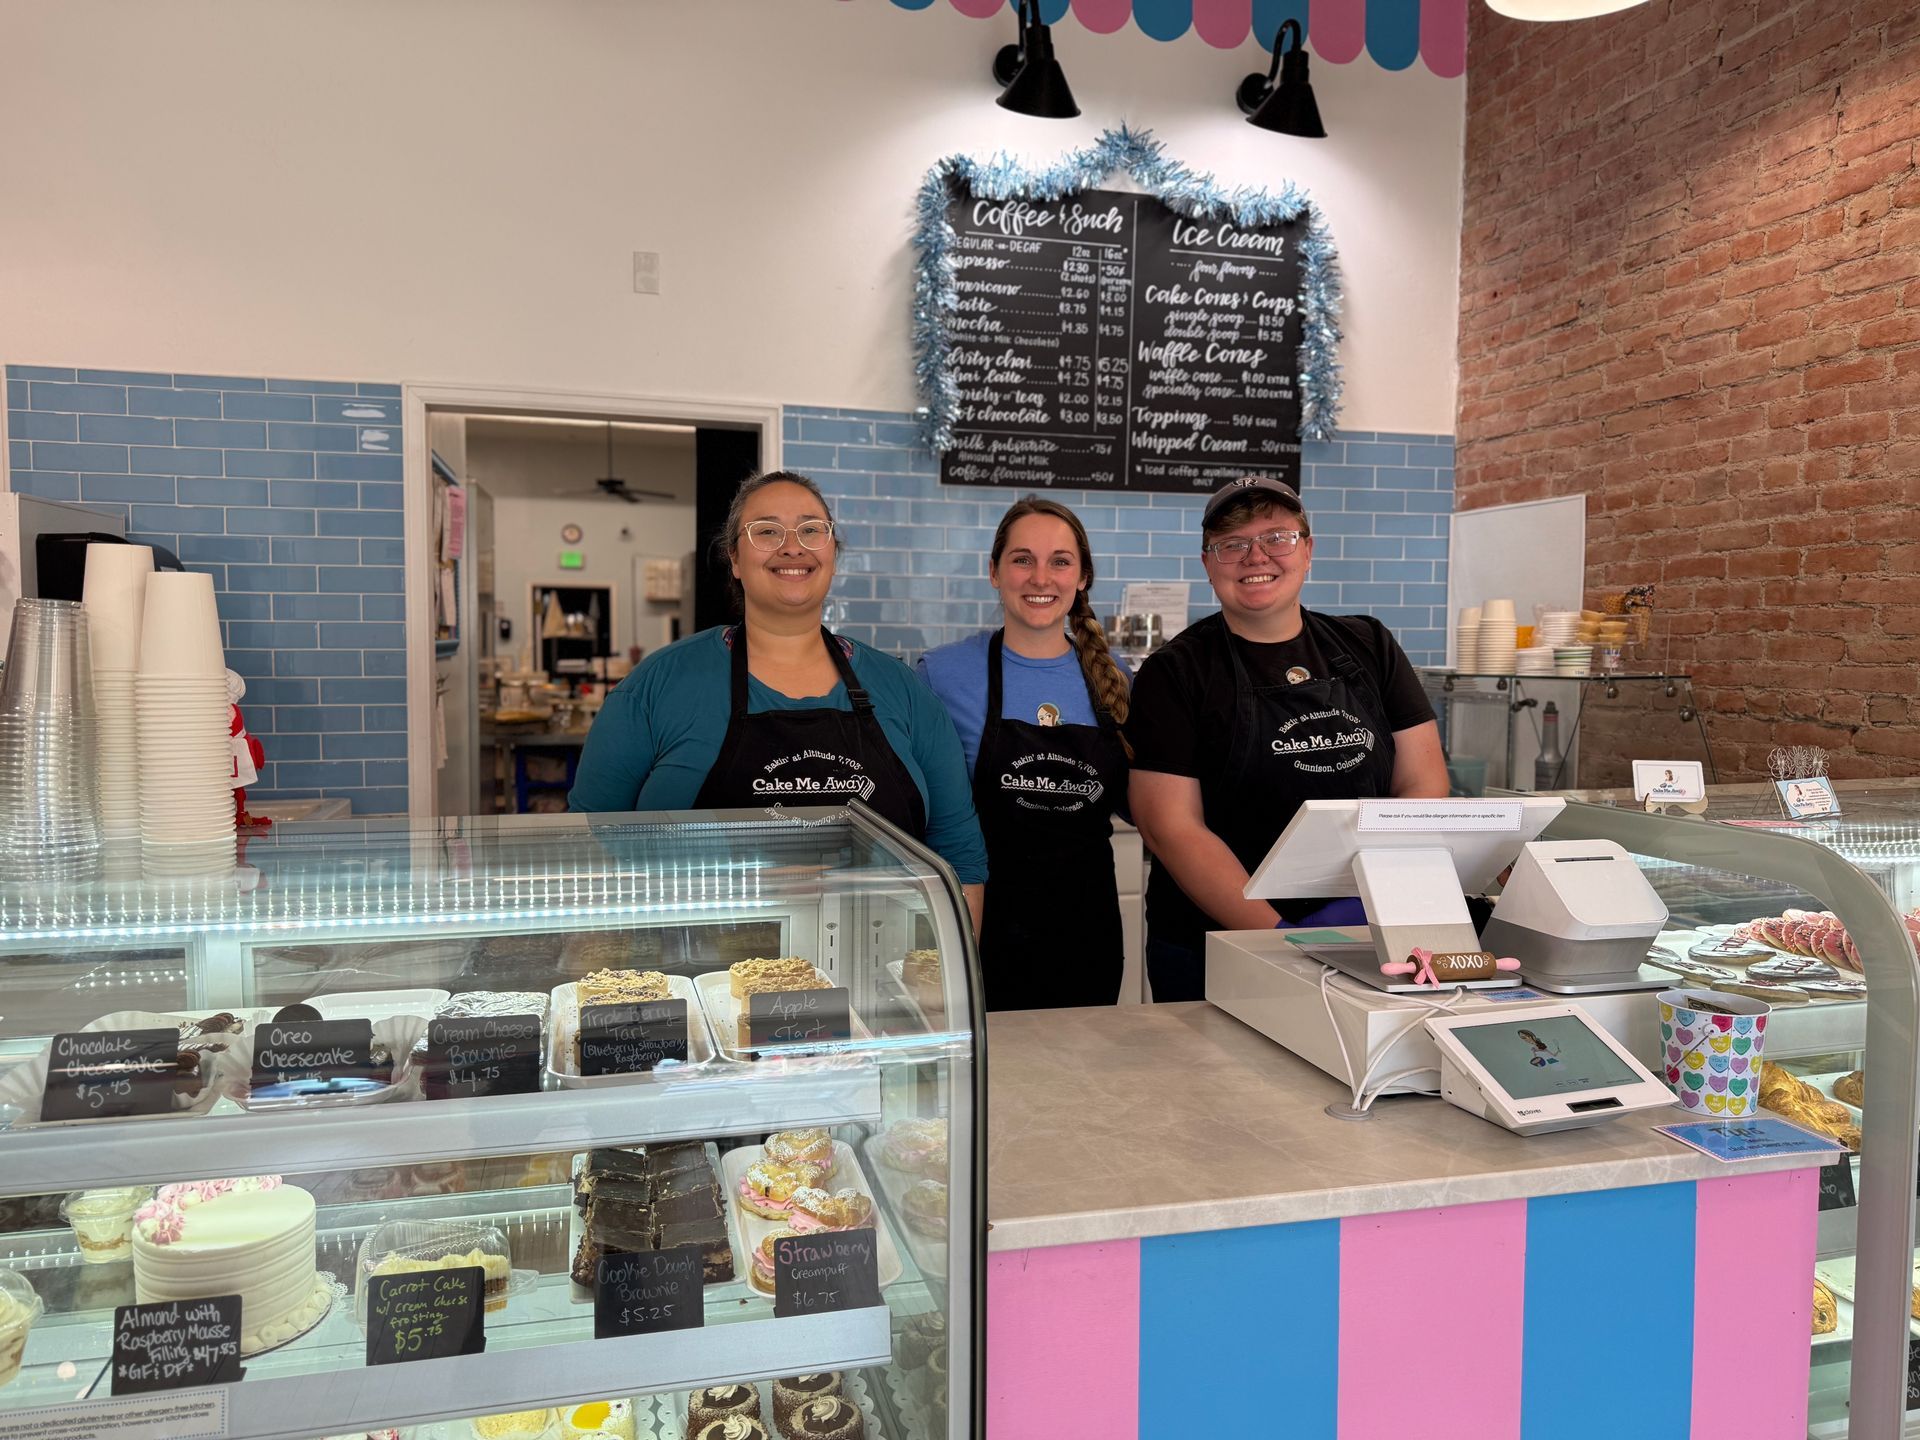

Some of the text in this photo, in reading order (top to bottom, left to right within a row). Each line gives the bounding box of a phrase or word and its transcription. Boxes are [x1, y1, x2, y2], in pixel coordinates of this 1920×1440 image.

[973, 200, 1123, 235] Coffee Such
[1010, 239, 1042, 253] DECAF
[1172, 220, 1284, 255] Ice Cream
[959, 297, 998, 312] atte
[1059, 302, 1086, 314] $3.75
[1145, 284, 1295, 315] Cake Cones Cups
[1164, 309, 1209, 326] single
[1208, 312, 1245, 328] scoop
[1164, 325, 1206, 339] double
[1206, 328, 1240, 344] scoop
[946, 346, 995, 370] dirty
[996, 349, 1033, 369] chai
[1138, 341, 1267, 368] Waffle Cones
[983, 369, 1026, 383] latte
[1058, 371, 1089, 387] $4.25
[1149, 369, 1190, 384] waffle
[1192, 371, 1222, 383] cone
[1143, 383, 1202, 400] specialty
[1204, 386, 1235, 398] cone
[977, 405, 1051, 423] chocolate
[1132, 406, 1211, 430] Toppings
[1132, 431, 1200, 455] Whipped
[1201, 435, 1247, 452] Cream
[949, 464, 989, 481] coffee
[990, 466, 1056, 485] flavoring
[1168, 466, 1199, 476] coffee
[1309, 708, 1340, 719] Altitude
[1271, 731, 1366, 751] Cake Me Away
[764, 756, 789, 773] Bakin'
[792, 753, 801, 762] at
[803, 749, 835, 760] Altitude
[1012, 754, 1034, 769] Bakin'
[1047, 753, 1075, 765] Altitude
[1294, 752, 1365, 772] Gunnison, Colorado
[753, 777, 864, 792] Cake Me Away
[1001, 774, 1095, 794] Cake Me Away
[1449, 954, 1483, 969] XOXO
[769, 996, 819, 1024] Apple
[271, 1028, 312, 1046] Oreo
[433, 1021, 533, 1045] Cream Cheese
[610, 1026, 649, 1040] Tart
[774, 1018, 826, 1040] Tart
[58, 1037, 137, 1056] Chocolate
[448, 1044, 517, 1067] Brownie
[260, 1048, 356, 1068] Cheesecake
[615, 1051, 665, 1064] Raspberry)
[449, 1067, 500, 1093] $4.75
[76, 1079, 131, 1108] $5.45
[778, 1241, 871, 1266] Strawberry
[598, 1255, 696, 1284] Cookie Dough
[380, 1276, 466, 1301] Carrot Cake
[616, 1280, 680, 1302] Brownie
[120, 1303, 220, 1329] Almond with
[376, 1301, 390, 1315] w/
[619, 1304, 674, 1325] $5.25
[389, 1311, 449, 1328] frosting
[116, 1328, 186, 1355] Raspberry
[395, 1324, 442, 1354] $5.75
[148, 1342, 237, 1367] Filling $47.85
[40, 1417, 76, 1427] dedicated
[166, 1413, 191, 1421] kitchen
